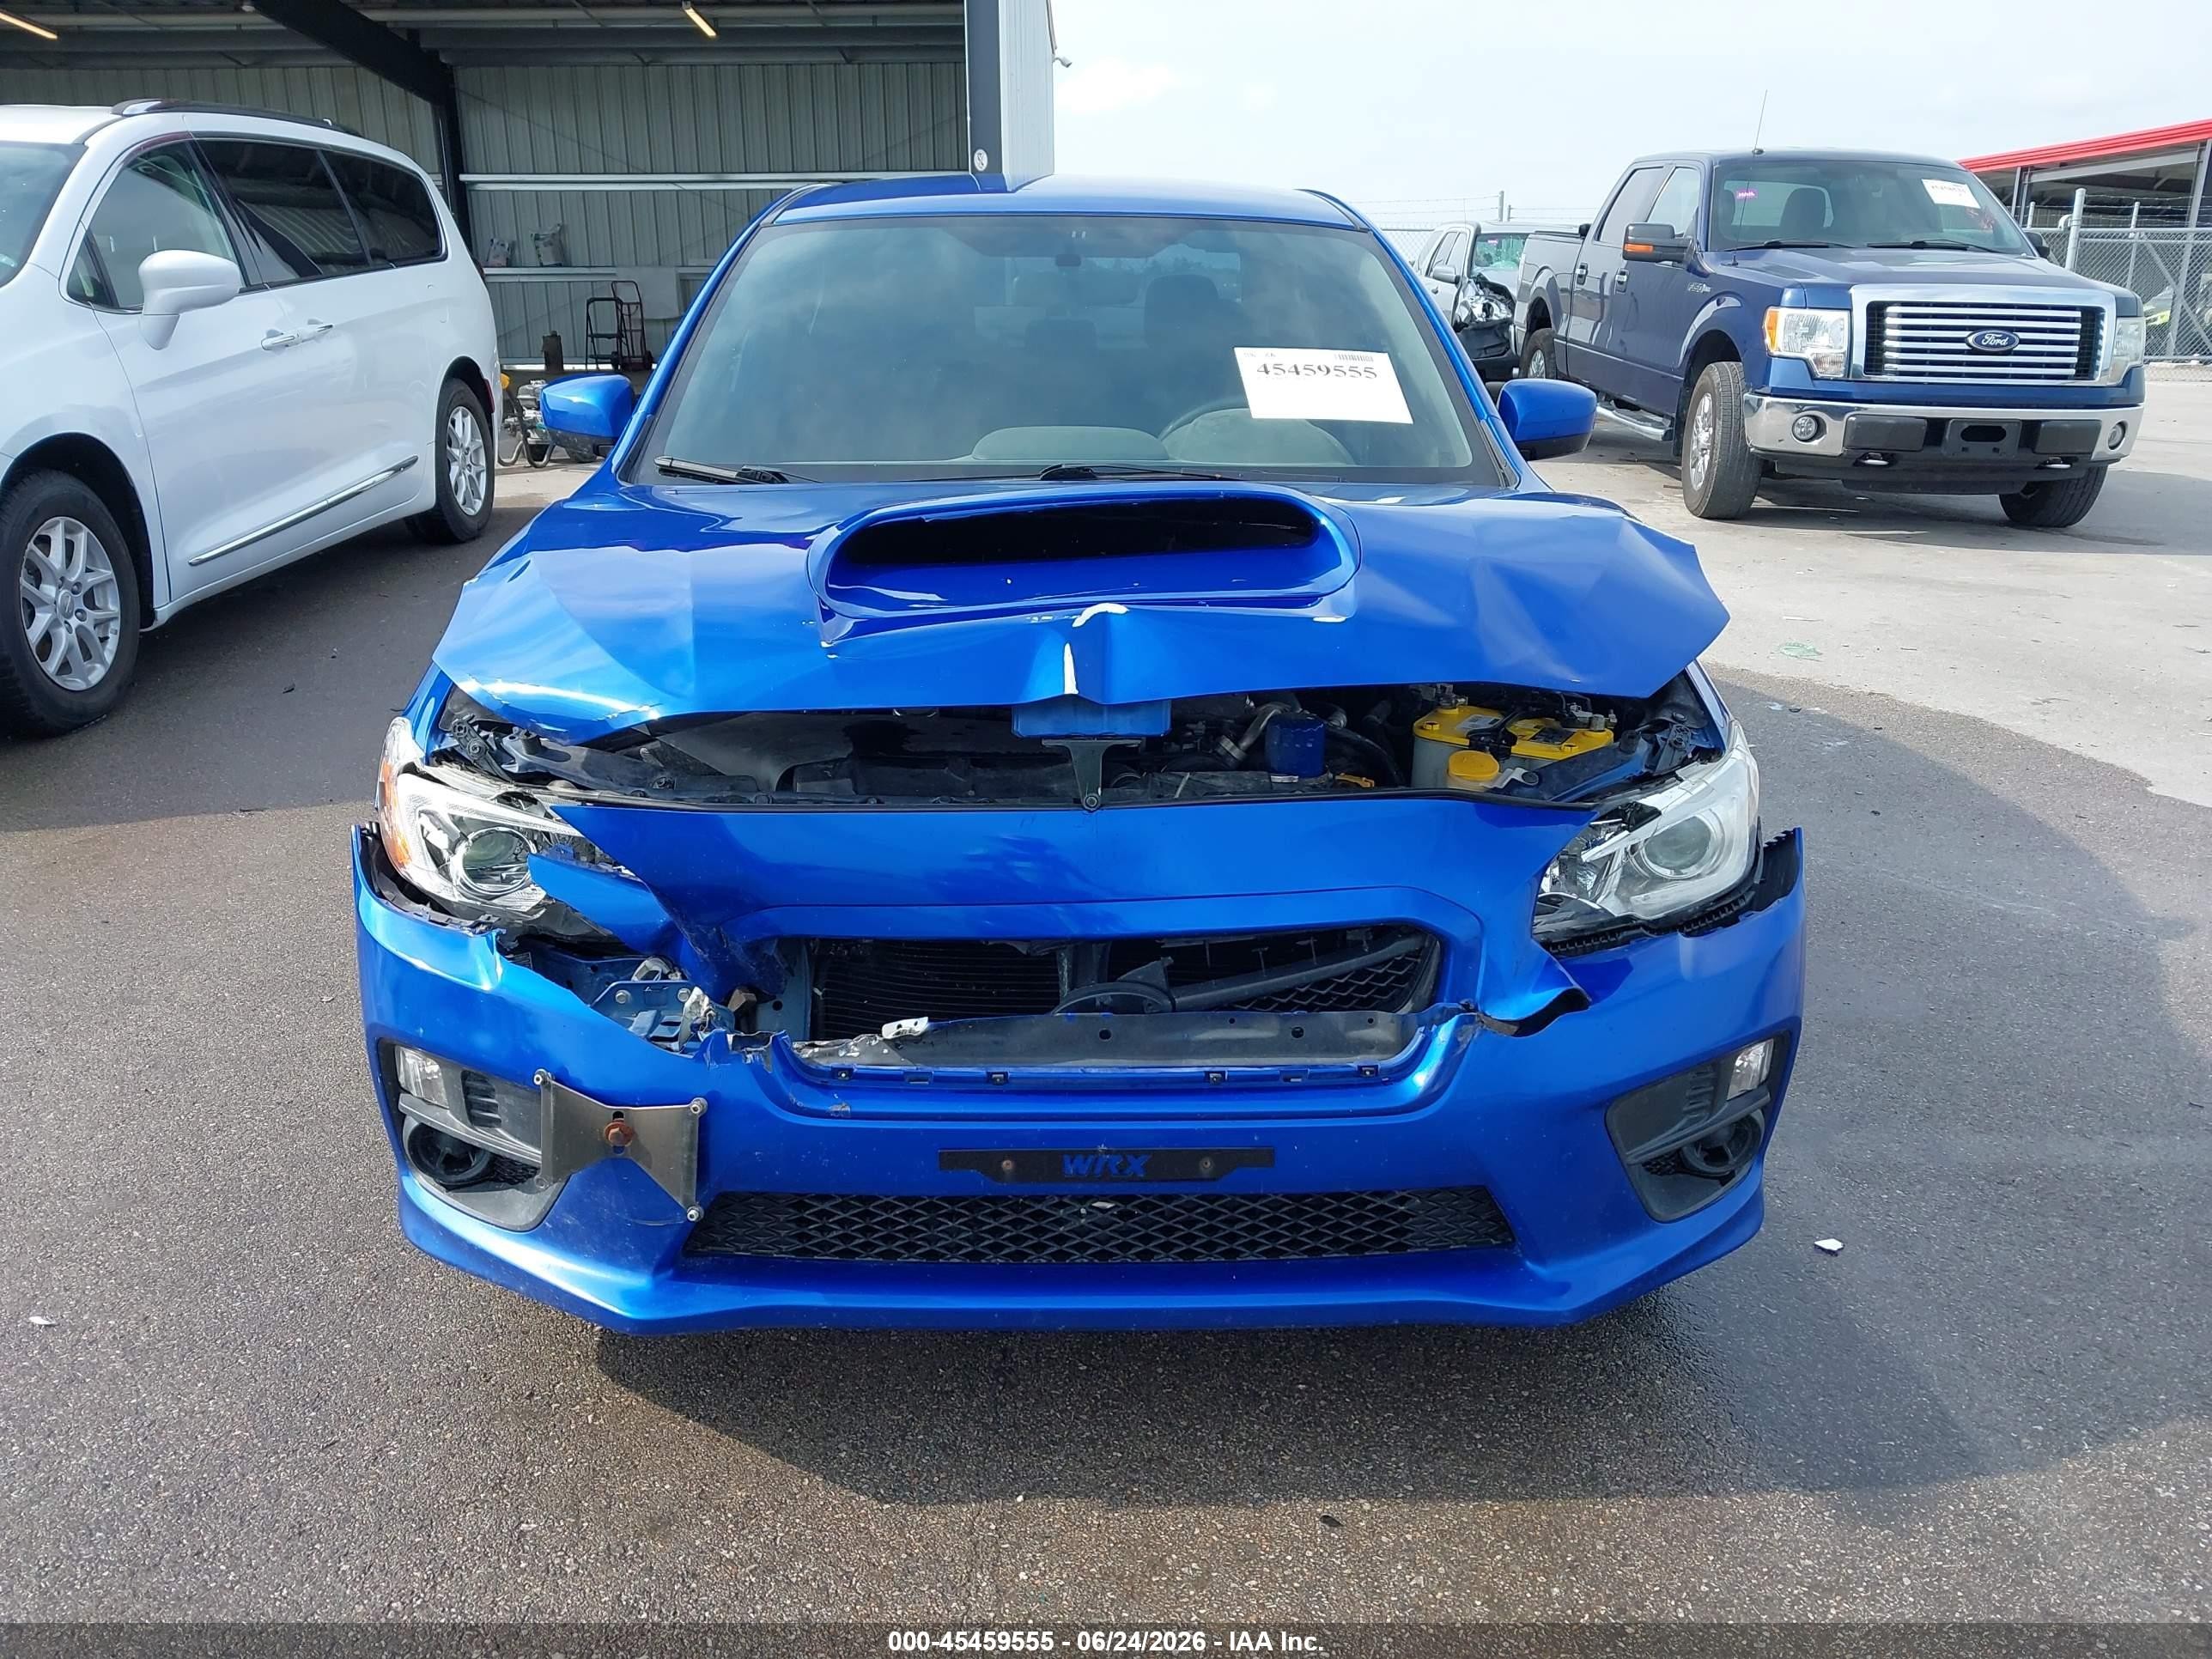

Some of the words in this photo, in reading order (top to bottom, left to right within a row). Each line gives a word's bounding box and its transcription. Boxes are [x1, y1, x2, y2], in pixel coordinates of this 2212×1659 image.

[1981, 333, 2009, 345] Ford
[1256, 362, 1378, 380] 45459555
[1062, 1154, 1152, 1177] WRX
